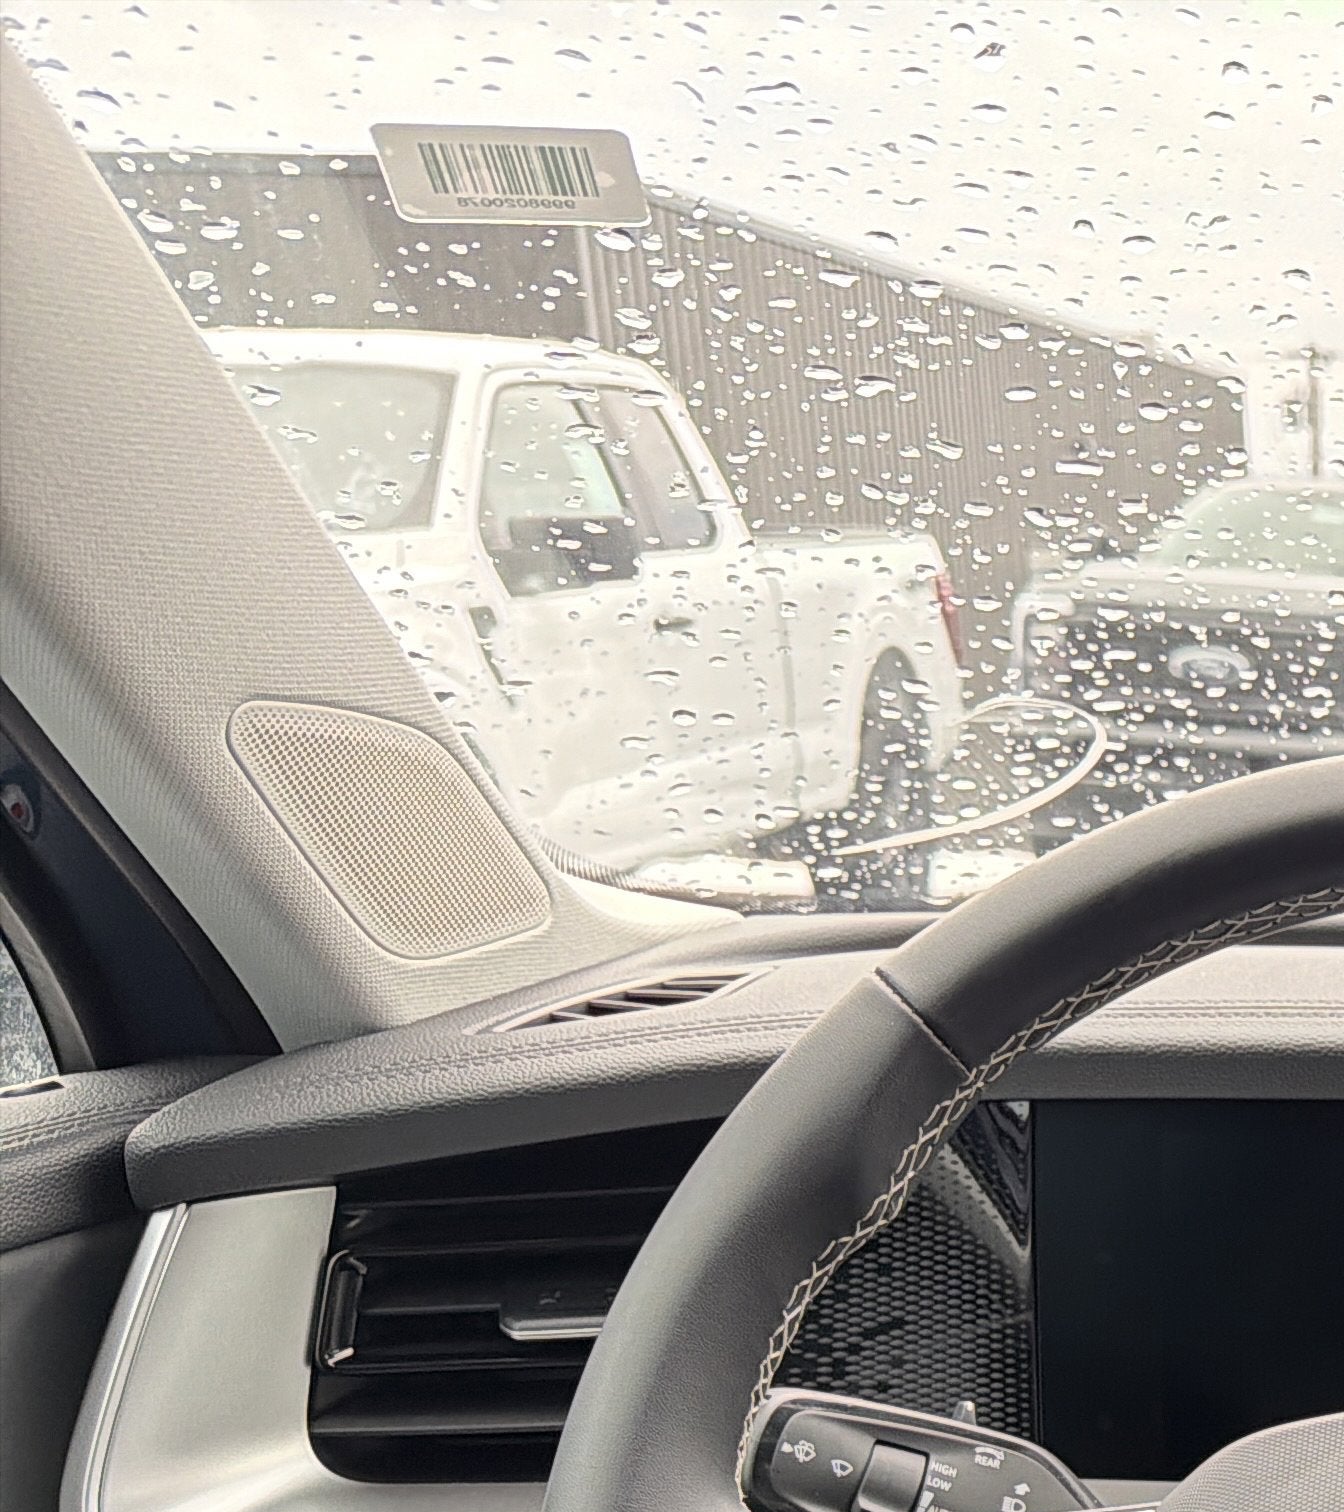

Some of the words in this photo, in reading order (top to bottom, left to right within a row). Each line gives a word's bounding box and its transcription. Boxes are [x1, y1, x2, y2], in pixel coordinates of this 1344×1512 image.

[930, 1460, 958, 1478] HIGH
[974, 1454, 1001, 1470] REAR
[926, 1475, 953, 1492] LOW
